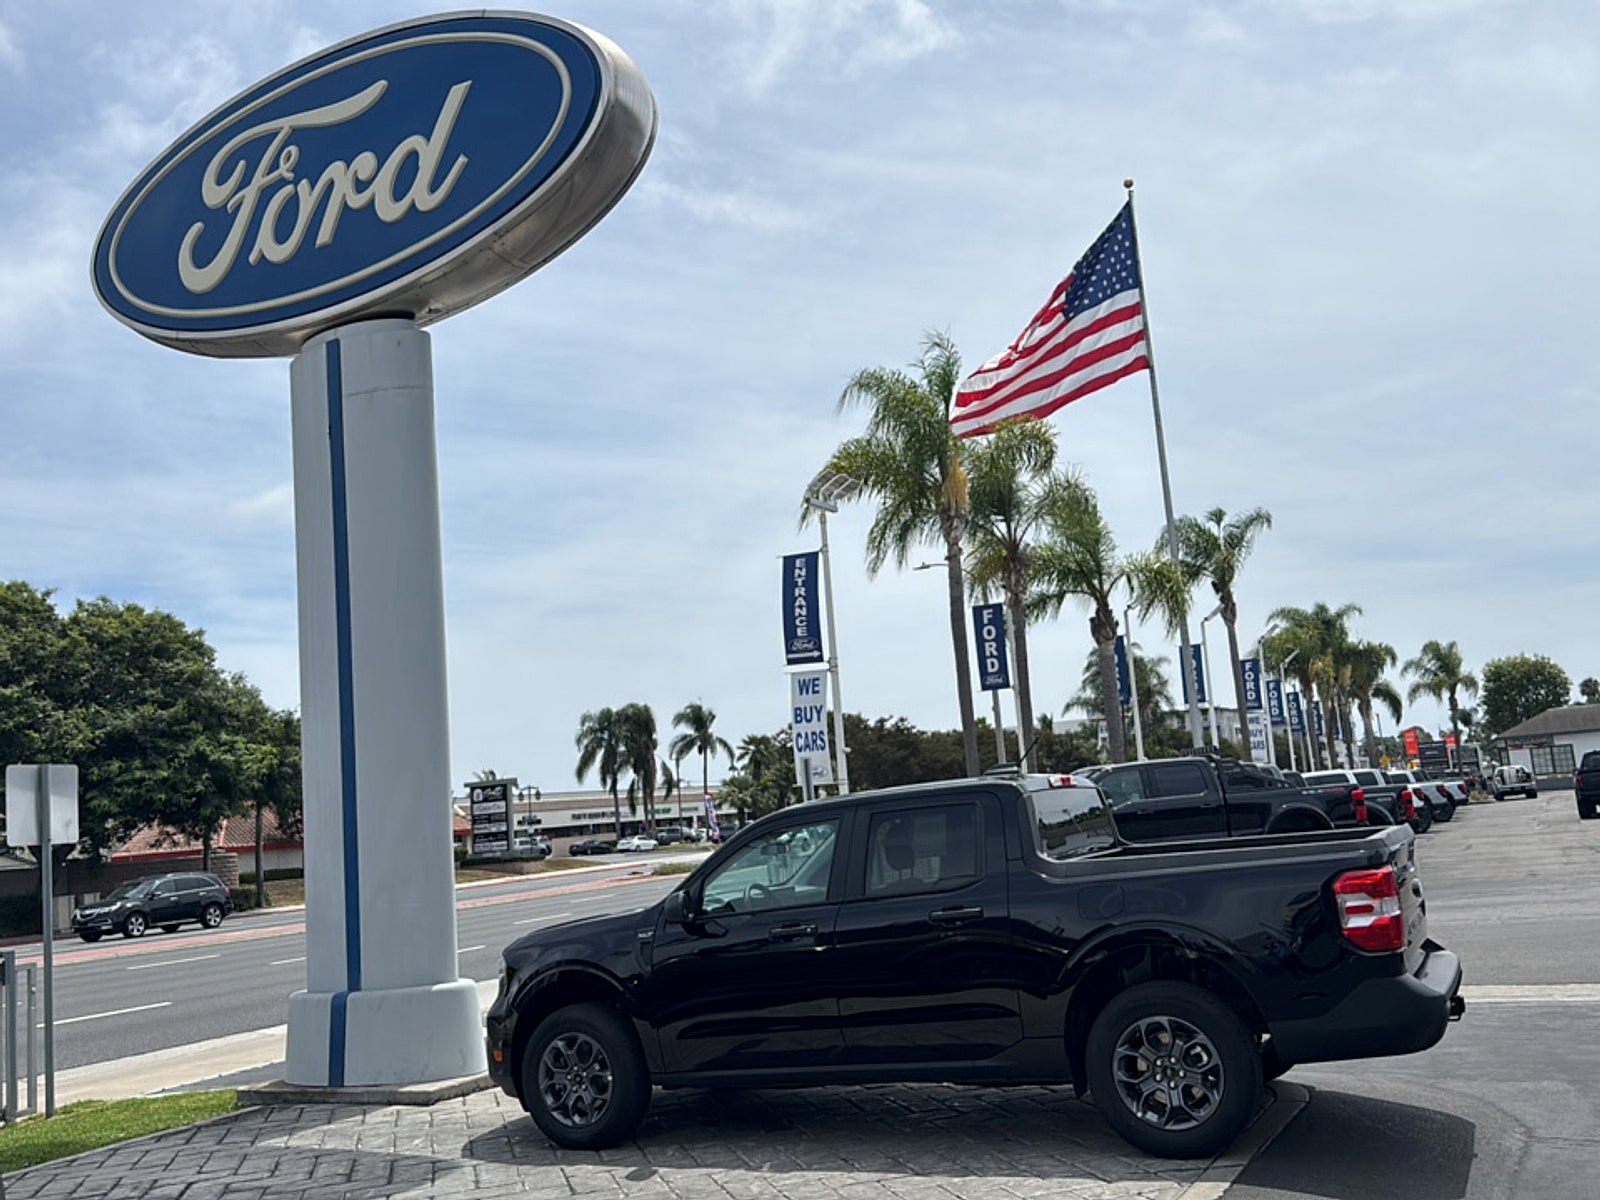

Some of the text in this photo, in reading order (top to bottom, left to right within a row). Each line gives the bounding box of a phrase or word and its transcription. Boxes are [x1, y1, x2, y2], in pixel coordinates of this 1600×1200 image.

[178, 79, 472, 294] Ford
[794, 558, 807, 636] ENTRANCE
[982, 608, 1000, 673] FORD
[798, 677, 820, 696] WE
[1245, 662, 1256, 700] FORD
[1269, 682, 1280, 715] FORD
[794, 705, 823, 724] BUY
[795, 730, 826, 752] CARS
